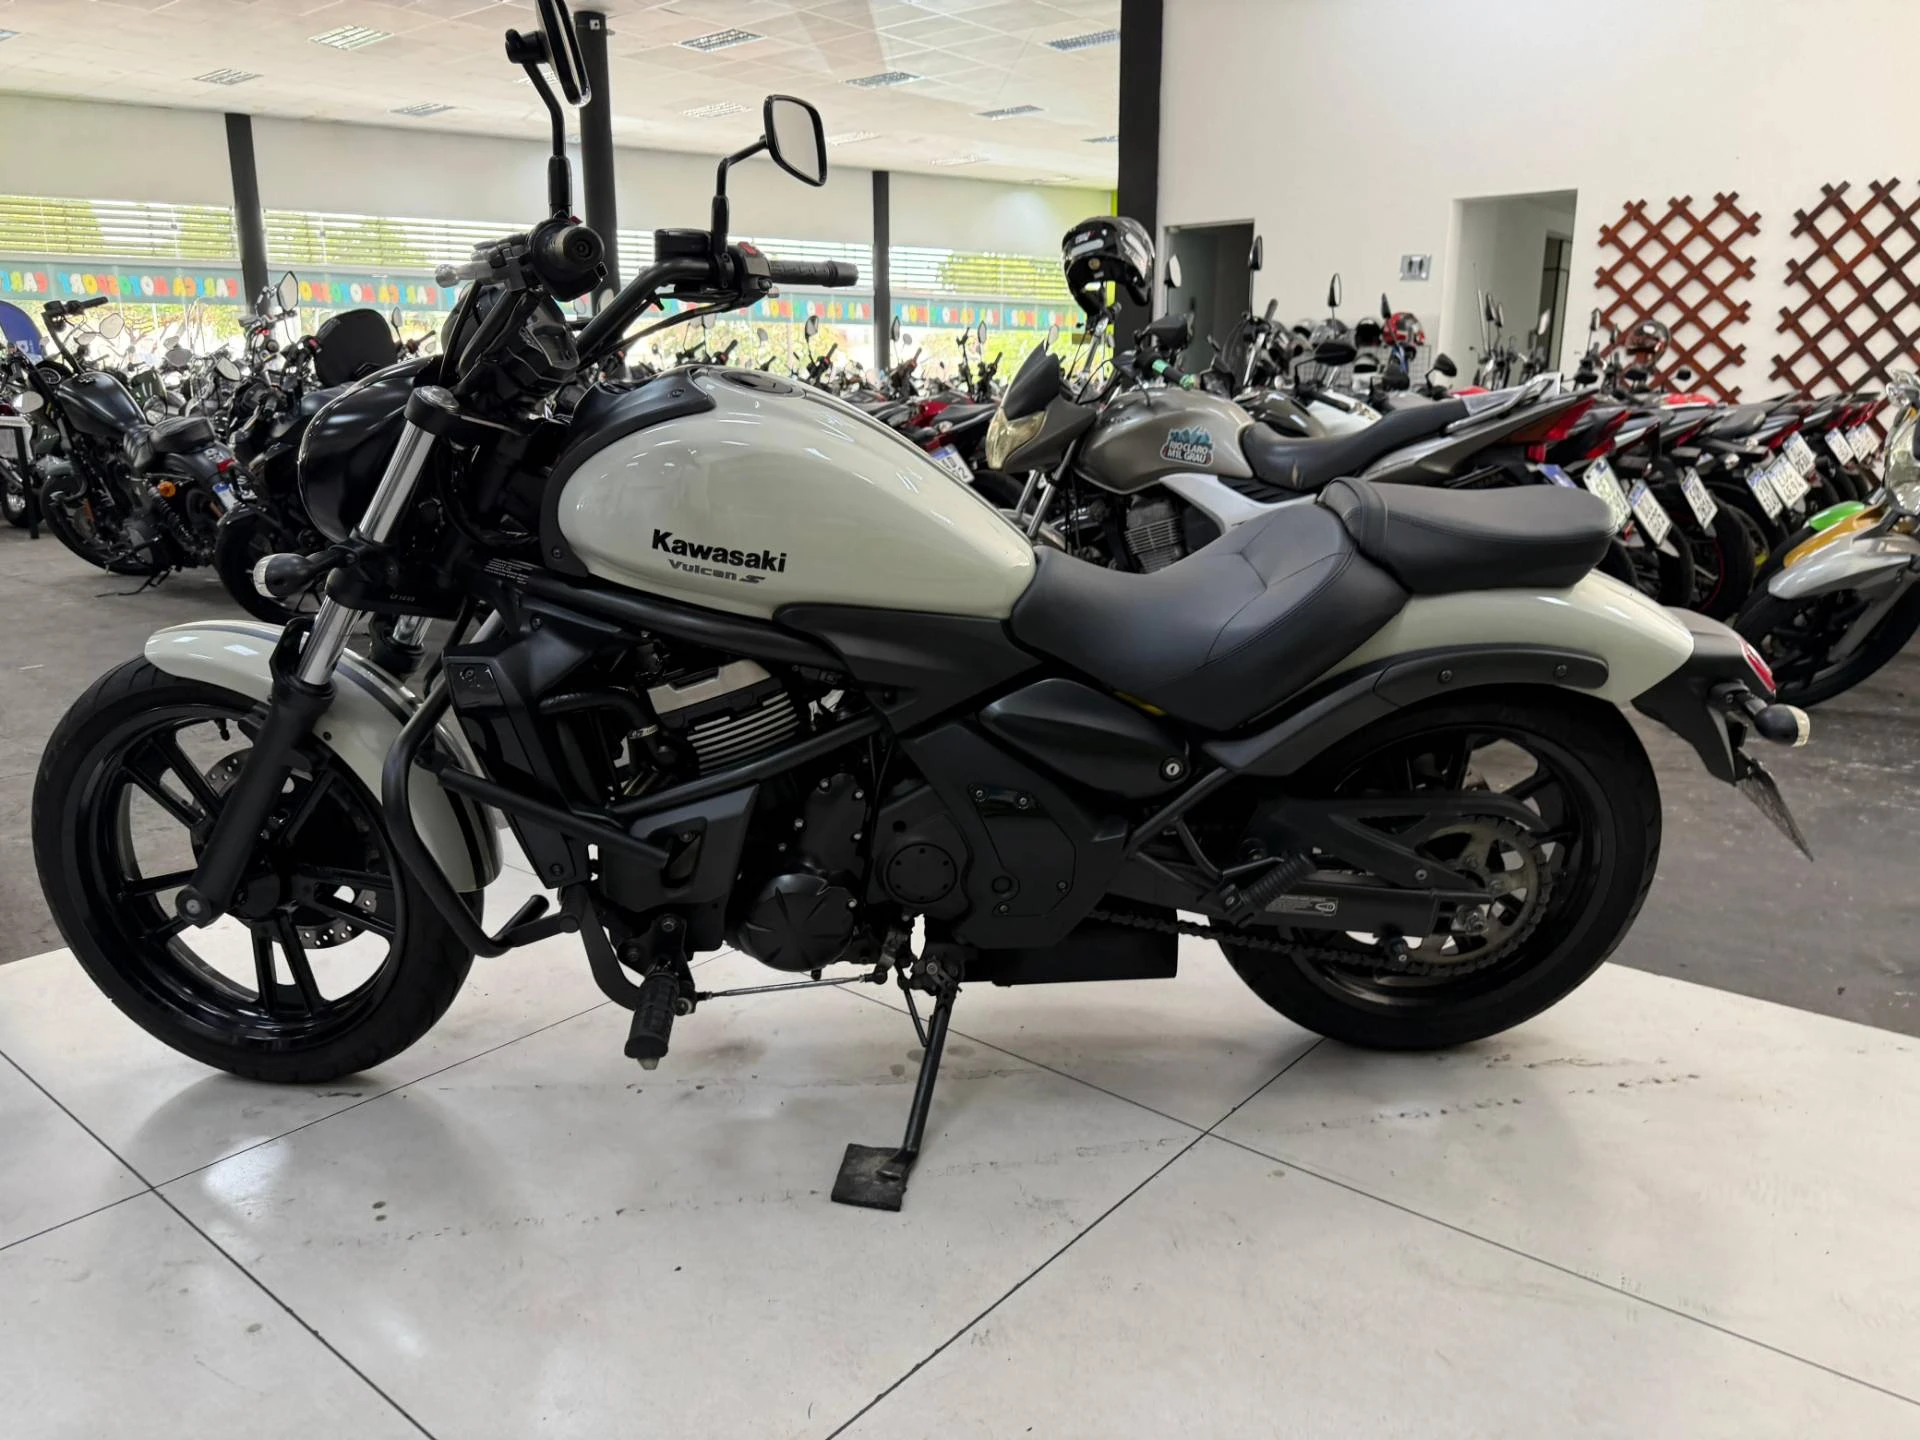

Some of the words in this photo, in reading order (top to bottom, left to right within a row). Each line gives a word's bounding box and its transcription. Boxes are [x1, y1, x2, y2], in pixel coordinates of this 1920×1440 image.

[1183, 443, 1208, 455] CLARO
[1183, 452, 1207, 464] GRAU
[651, 528, 787, 573] Kawasaki
[667, 557, 738, 581] Vulcan
[738, 574, 766, 584] S
